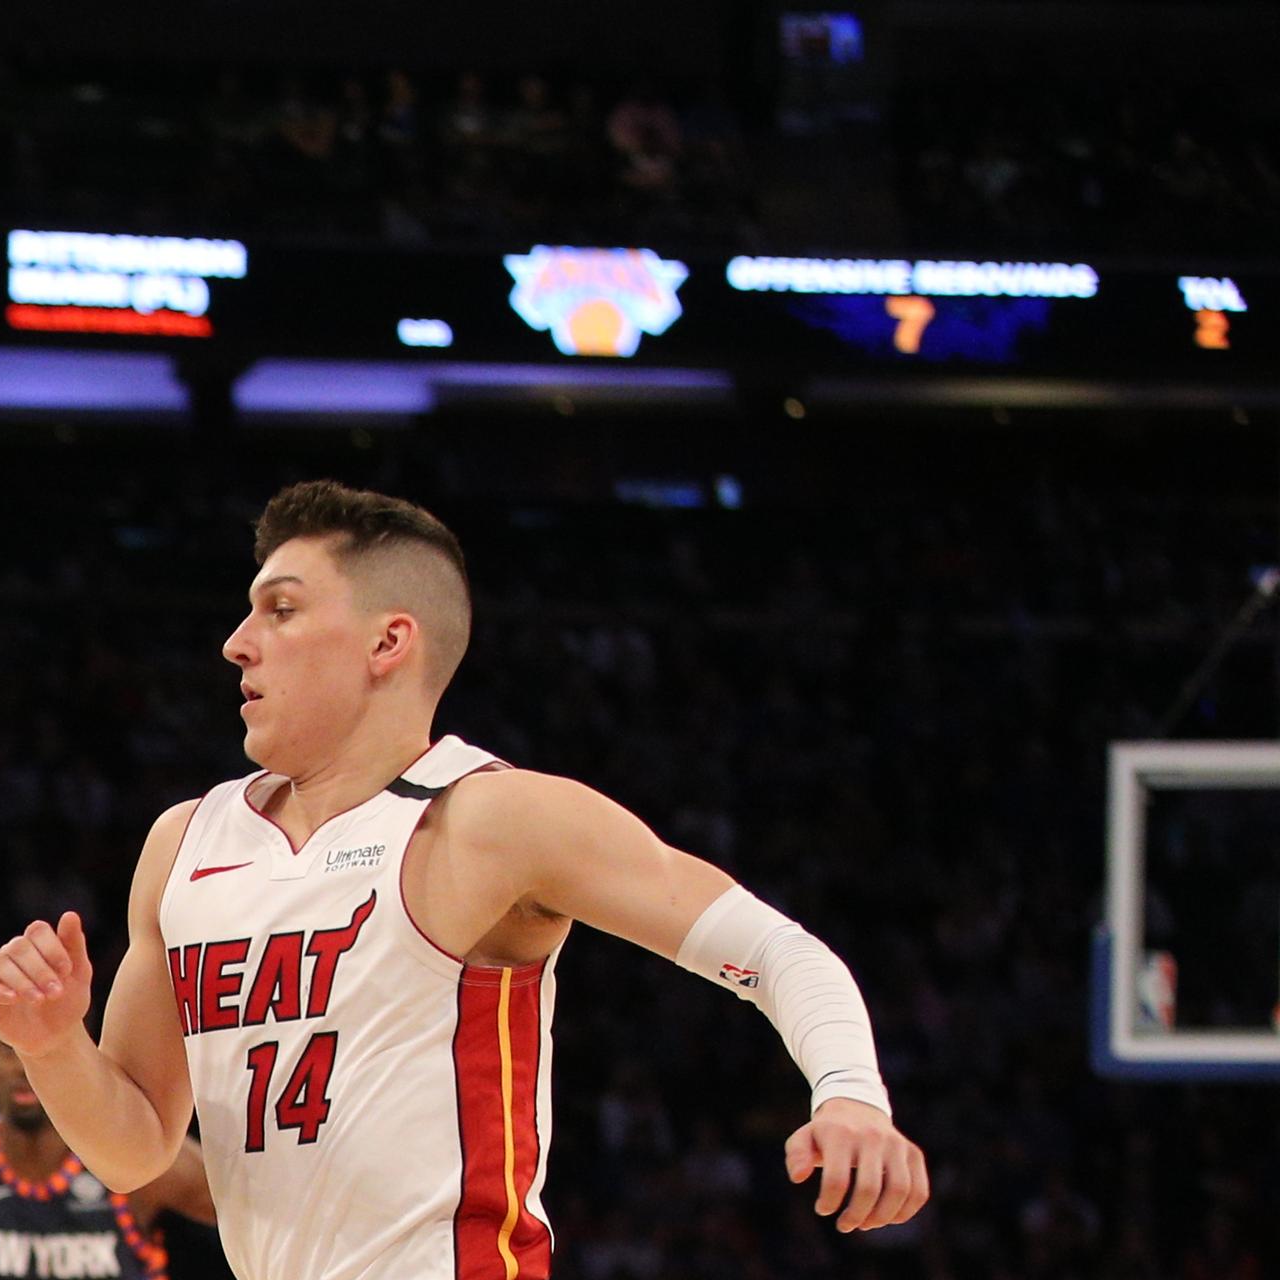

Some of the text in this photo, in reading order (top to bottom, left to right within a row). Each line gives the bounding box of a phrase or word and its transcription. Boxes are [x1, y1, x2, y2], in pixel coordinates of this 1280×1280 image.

[886, 296, 935, 354] 7
[326, 844, 386, 865] Ultimate
[167, 888, 377, 1038] HEAT
[244, 1030, 339, 1154] 14
[30, 1231, 122, 1279] YORK
